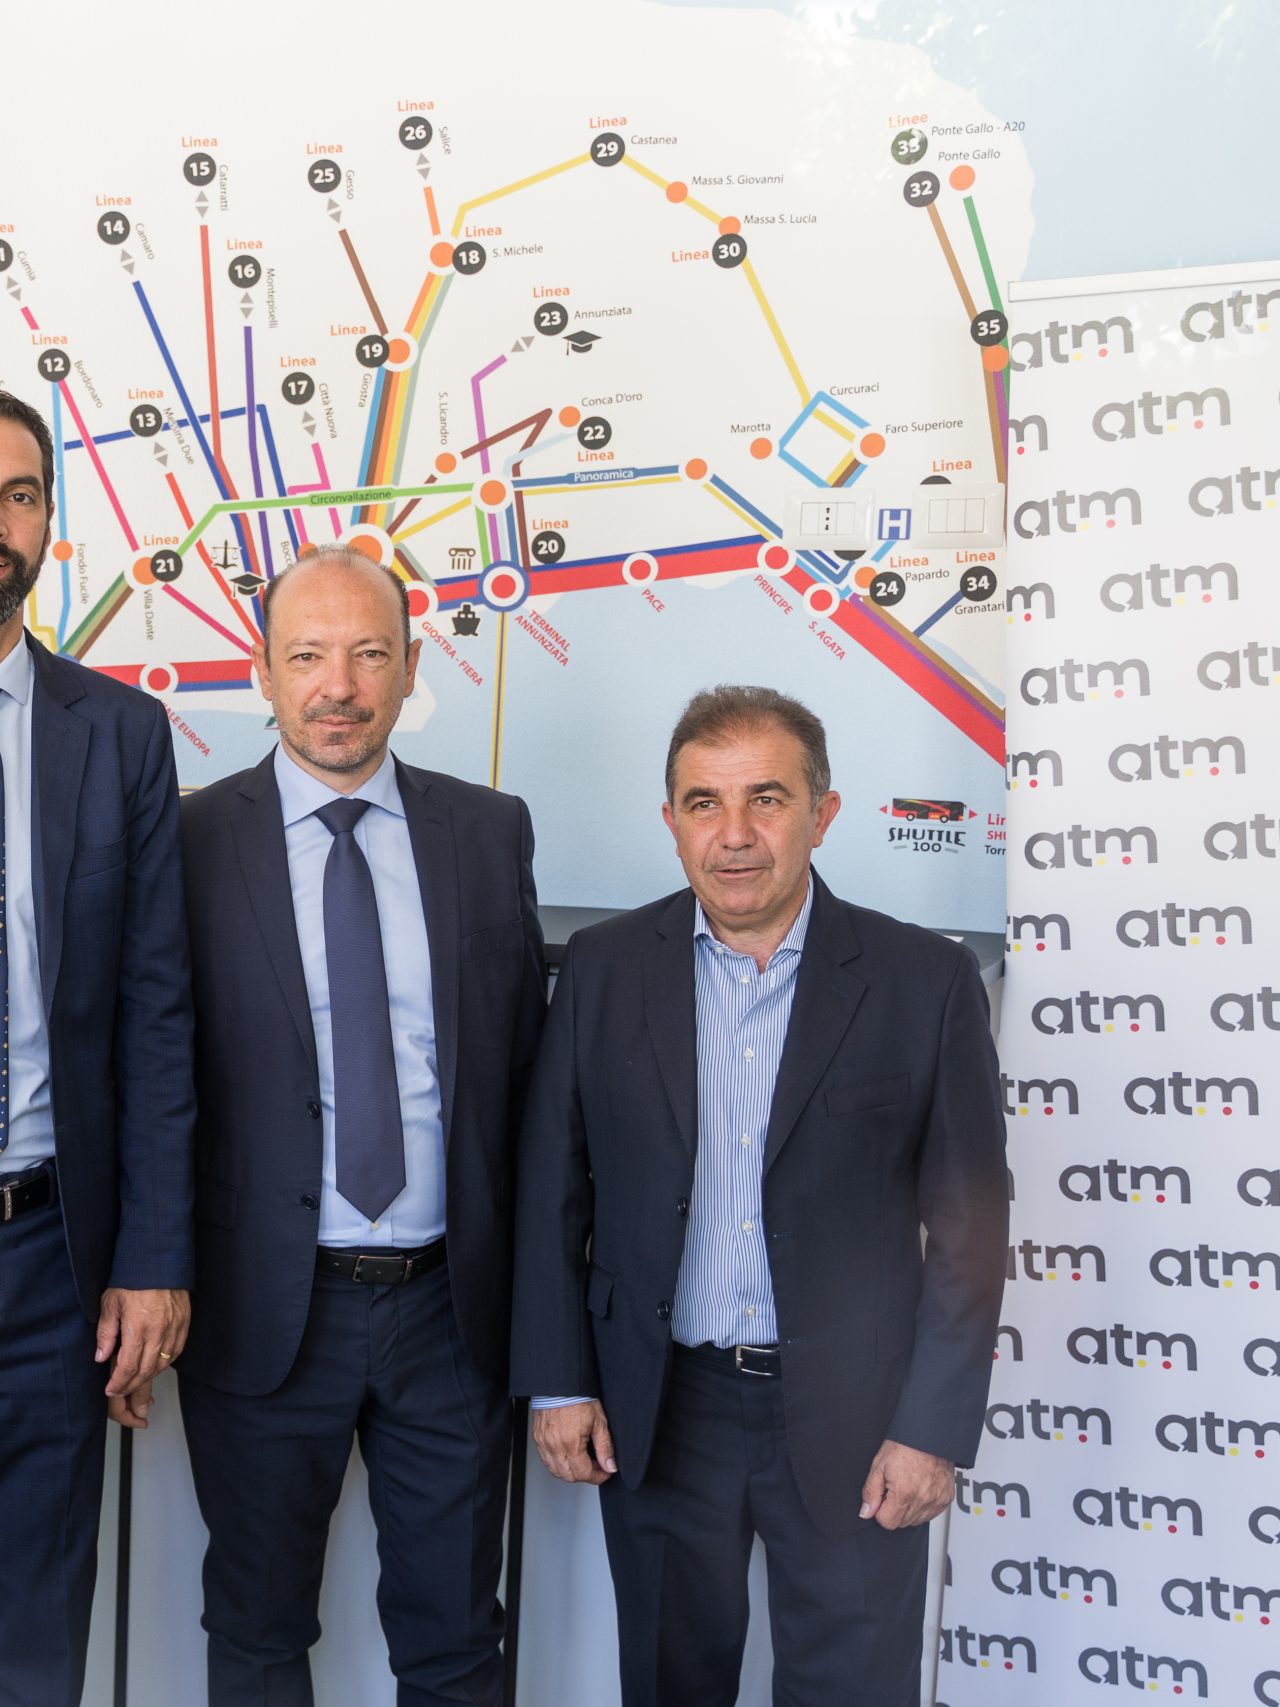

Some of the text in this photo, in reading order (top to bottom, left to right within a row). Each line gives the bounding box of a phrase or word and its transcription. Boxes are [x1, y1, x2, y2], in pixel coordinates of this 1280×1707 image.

[397, 100, 435, 112] Linea
[589, 116, 627, 129] Linea
[888, 112, 929, 129] Linee
[931, 120, 1026, 137] Ponte Gallo A20
[404, 124, 427, 141] 26
[438, 126, 452, 155] Salice
[630, 134, 678, 145] Castanea
[181, 135, 218, 148] Linea
[306, 142, 343, 155] Linea
[596, 141, 619, 158] 29
[938, 148, 1001, 162] Ponte Gallo
[189, 161, 211, 177] 15
[313, 167, 335, 184] 25
[218, 163, 229, 212] Catarratti
[345, 169, 356, 201] Gesso
[691, 173, 784, 186] Massa S. Giovanni
[910, 179, 933, 198] 32
[95, 194, 132, 207] Linea
[103, 219, 125, 236] 14
[743, 213, 817, 225] Massa S. Lucia
[465, 226, 503, 238] Linea
[134, 222, 155, 261] Camaro
[226, 239, 263, 251] Linea
[458, 249, 480, 266] 18
[492, 242, 544, 259] S. Michele
[671, 249, 710, 263] Linea
[717, 242, 741, 260] 30
[17, 250, 37, 282] Cumia
[234, 263, 256, 279] 16
[265, 267, 279, 329] Montepiselli
[533, 286, 570, 299] Linea
[539, 310, 562, 327] 23
[574, 305, 633, 320] Annunziata
[330, 325, 367, 336] Linea
[977, 318, 1001, 337] 35
[31, 334, 68, 346] Linea
[1010, 316, 1134, 372] atm
[361, 342, 384, 359] 19
[43, 357, 66, 373] 12
[280, 356, 317, 368] Linea
[73, 359, 103, 409] Bordonaro
[287, 379, 308, 396] 17
[358, 372, 373, 408] Giostra
[829, 382, 880, 397] Curcuraci
[127, 388, 165, 400] Linea
[580, 394, 614, 408] Conca
[135, 411, 158, 430] 13
[324, 407, 338, 439] Nuova
[1092, 387, 1231, 442] atm
[583, 424, 605, 441] 22
[730, 422, 771, 434] Marotta
[885, 418, 965, 435] Faro Superiore
[181, 444, 194, 465] Due
[577, 450, 615, 462] Linea
[932, 458, 973, 473] Linea
[573, 468, 634, 483] Panoramica
[310, 489, 392, 506] Circonvallazione
[532, 518, 569, 530] Linea
[143, 534, 180, 547] Linea
[537, 539, 559, 555] 20
[155, 557, 176, 574] 21
[889, 556, 929, 569] Linea
[956, 550, 996, 564] Linea
[76, 543, 89, 605] Fondo Fucile
[904, 569, 950, 583] Papardo
[876, 580, 900, 597] 24
[966, 575, 990, 592] 34
[640, 588, 666, 613] PACE
[753, 574, 794, 616] PRINCIPE
[143, 589, 155, 641] Villa Dante
[954, 601, 1006, 615] Granatari
[528, 609, 570, 652] TERMINAL
[514, 613, 569, 668] ANNUNZIATA
[808, 620, 846, 661] S. AGATA
[422, 621, 483, 687] GIOSTRA FIERA
[1020, 658, 1151, 706] atm
[178, 722, 210, 757] EUROPA
[887, 827, 967, 847] SHUTTLE
[912, 842, 942, 853] 100
[1024, 824, 1158, 870] atm
[1116, 902, 1253, 949] atm
[1067, 1323, 1198, 1372] atm
[991, 1556, 1118, 1607] atm
[1078, 1645, 1209, 1699] atm
